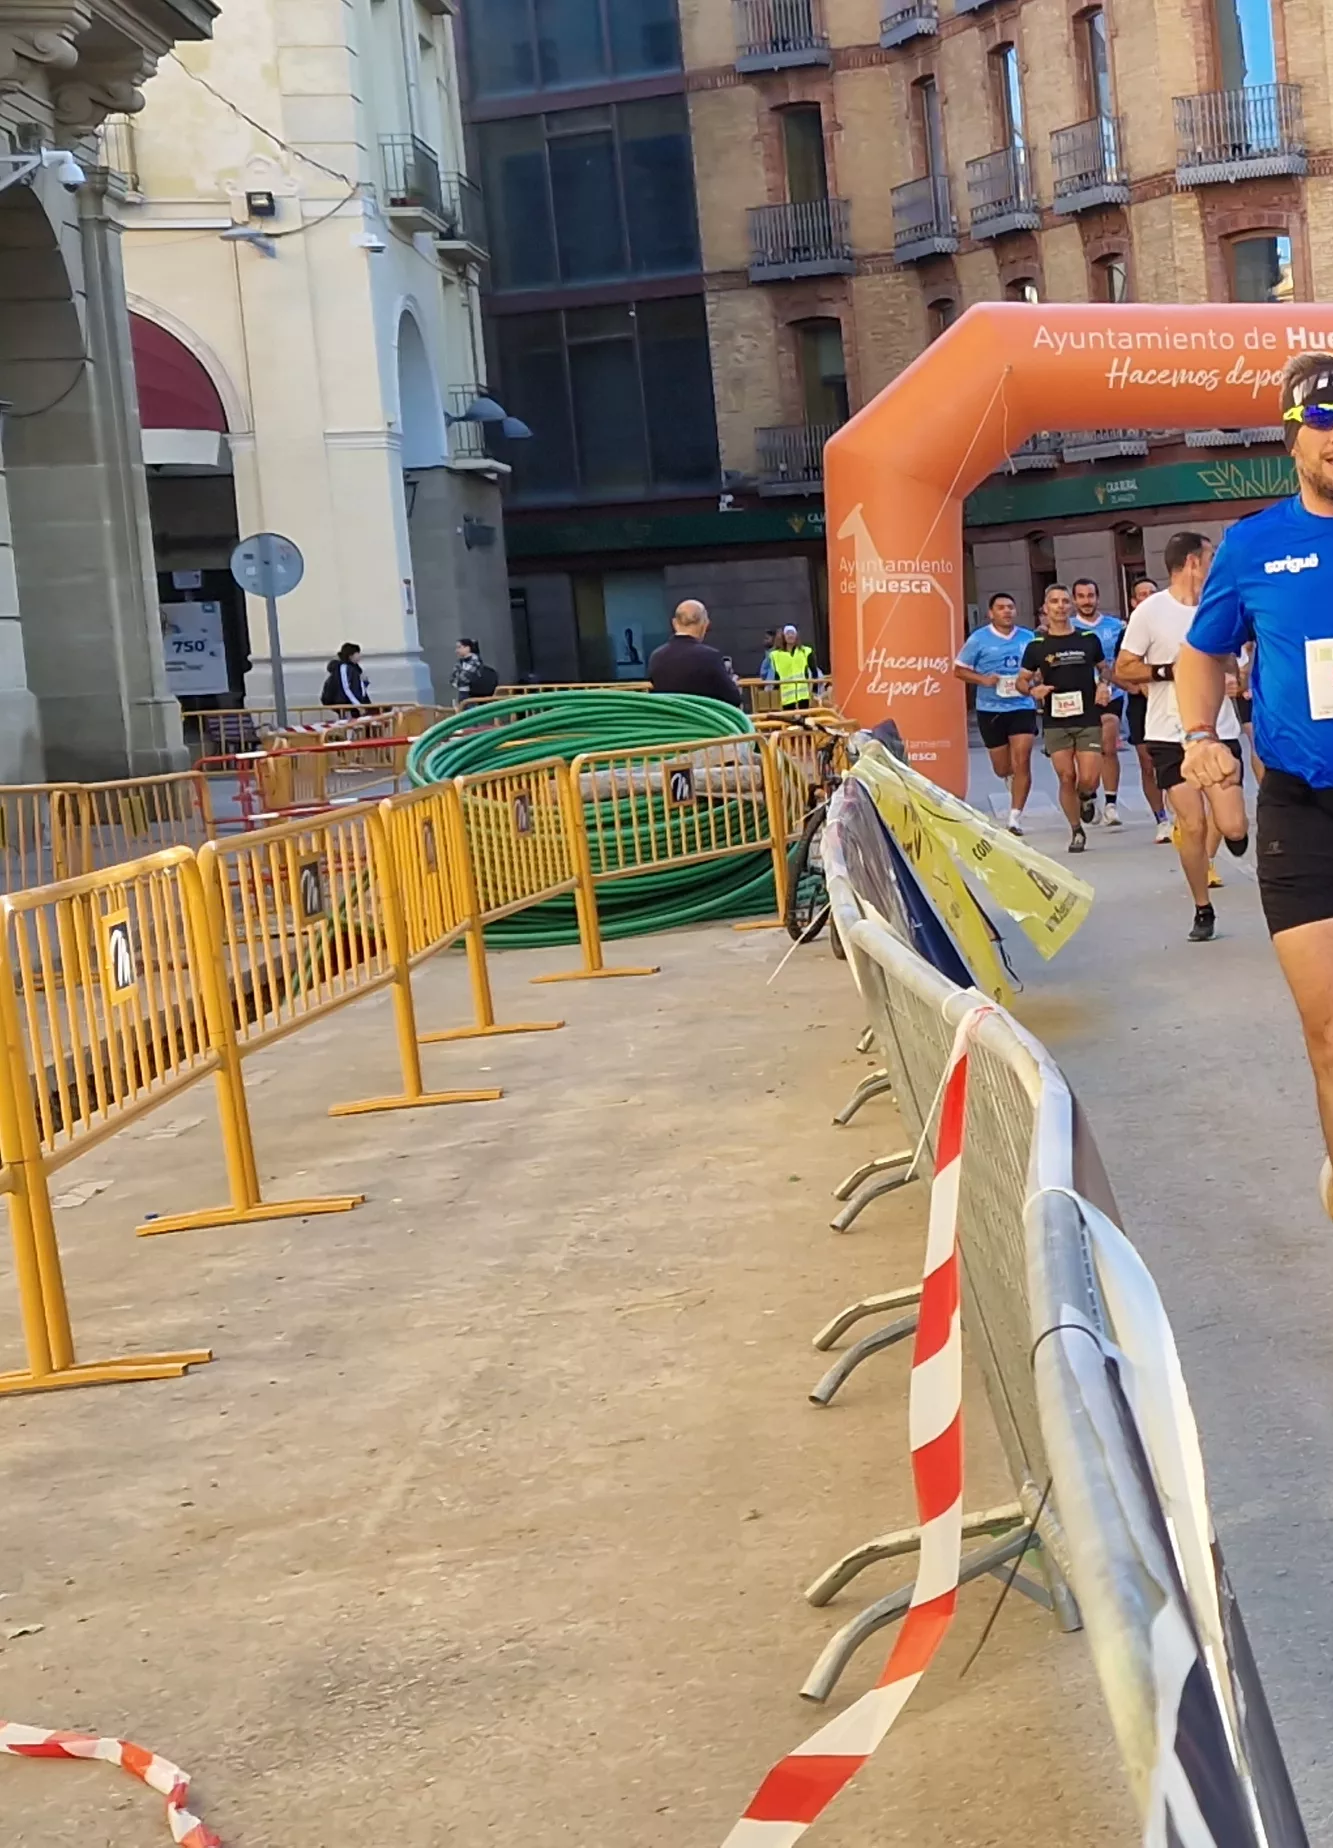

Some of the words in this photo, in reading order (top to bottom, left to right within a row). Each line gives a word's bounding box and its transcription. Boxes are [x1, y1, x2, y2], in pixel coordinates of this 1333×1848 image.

[1033, 326, 1235, 355] Ayuntamiento
[1243, 326, 1276, 350] de
[1104, 357, 1220, 390] Hacemos
[1225, 355, 1285, 399] depo
[839, 556, 953, 576] Ayuntamiento
[840, 580, 856, 594] de
[861, 578, 931, 594] Huesca
[866, 647, 950, 674] Hacemos
[866, 671, 941, 706] deporte
